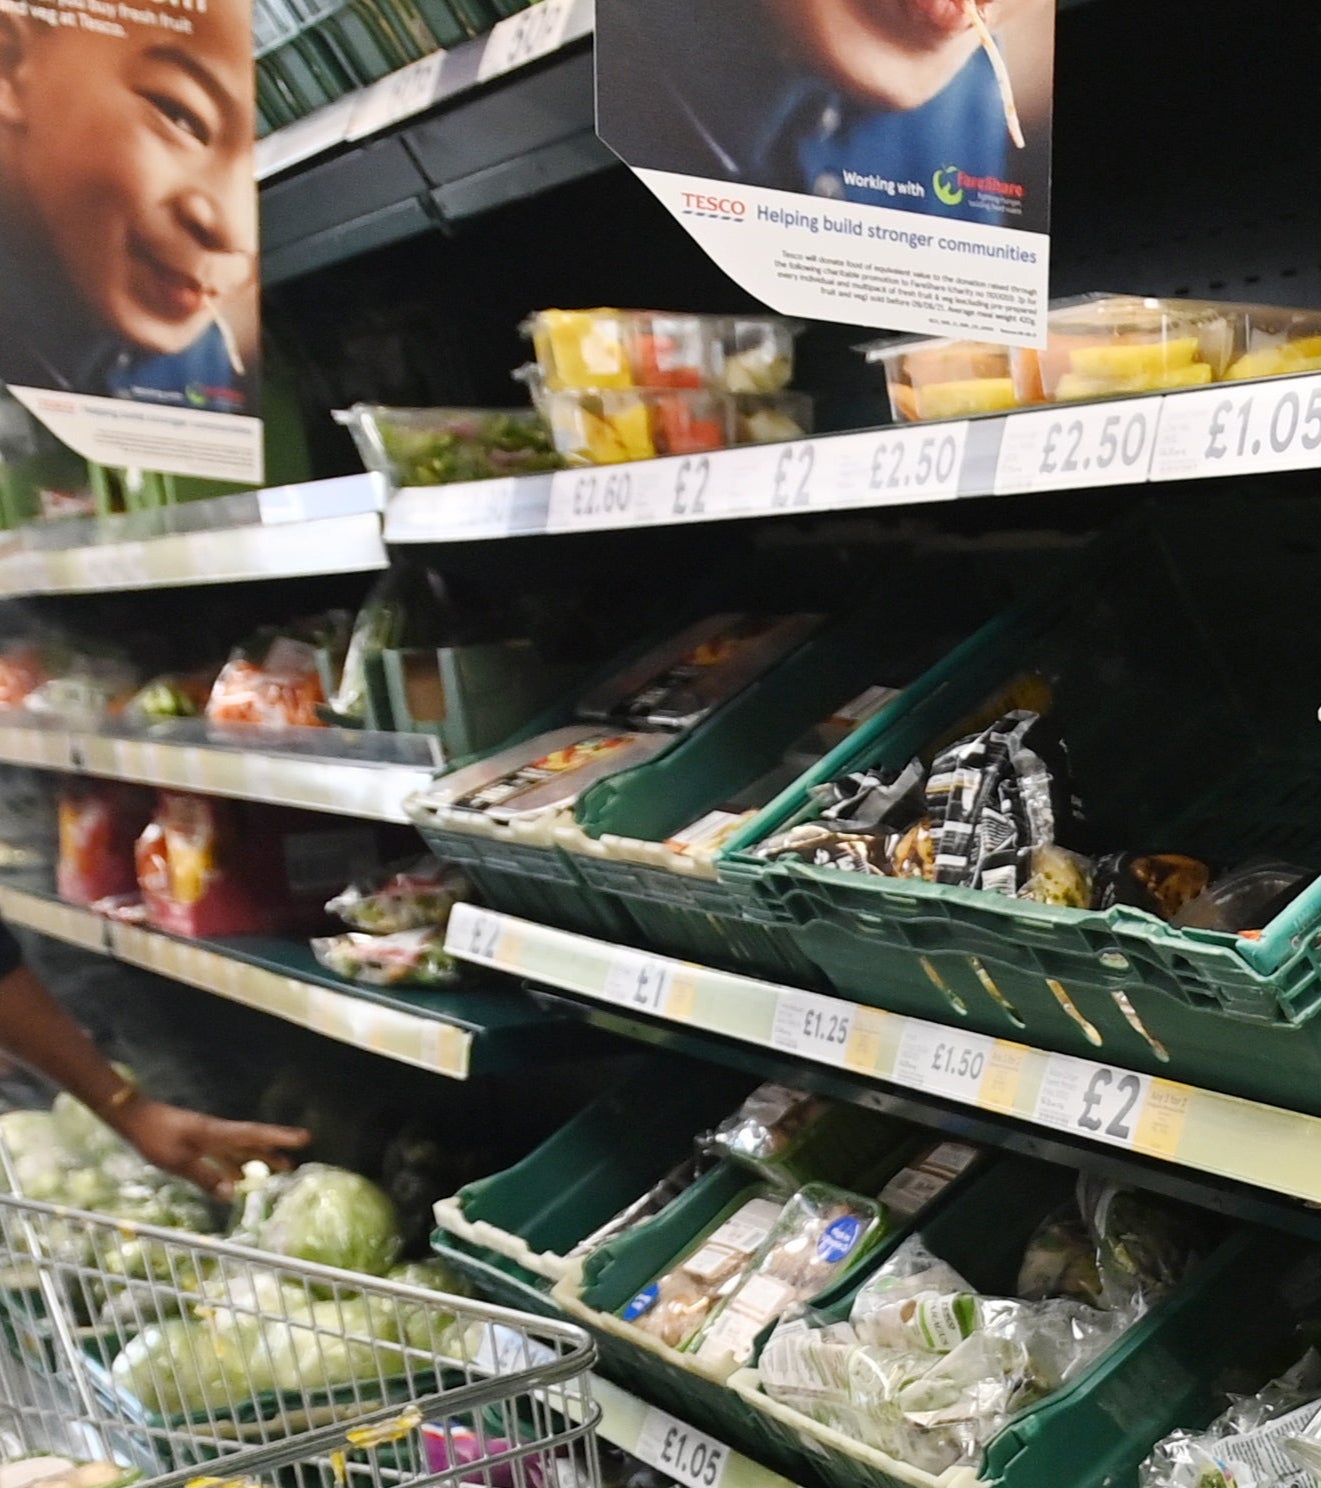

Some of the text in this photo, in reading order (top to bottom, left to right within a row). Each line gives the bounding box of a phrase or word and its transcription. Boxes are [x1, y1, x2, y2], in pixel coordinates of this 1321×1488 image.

[680, 191, 747, 217] TESCO
[842, 169, 896, 197] Working
[897, 177, 925, 199] with
[757, 204, 1037, 265] Helping build stronger communities
[868, 434, 958, 491] £2.50
[1037, 411, 1149, 475] £2.50
[671, 453, 712, 515] £2
[770, 440, 816, 508] £2
[803, 1009, 850, 1046] £1.25
[930, 1041, 985, 1081] £1.50
[1077, 1067, 1142, 1140] £2
[660, 1426, 722, 1487] £1.05
